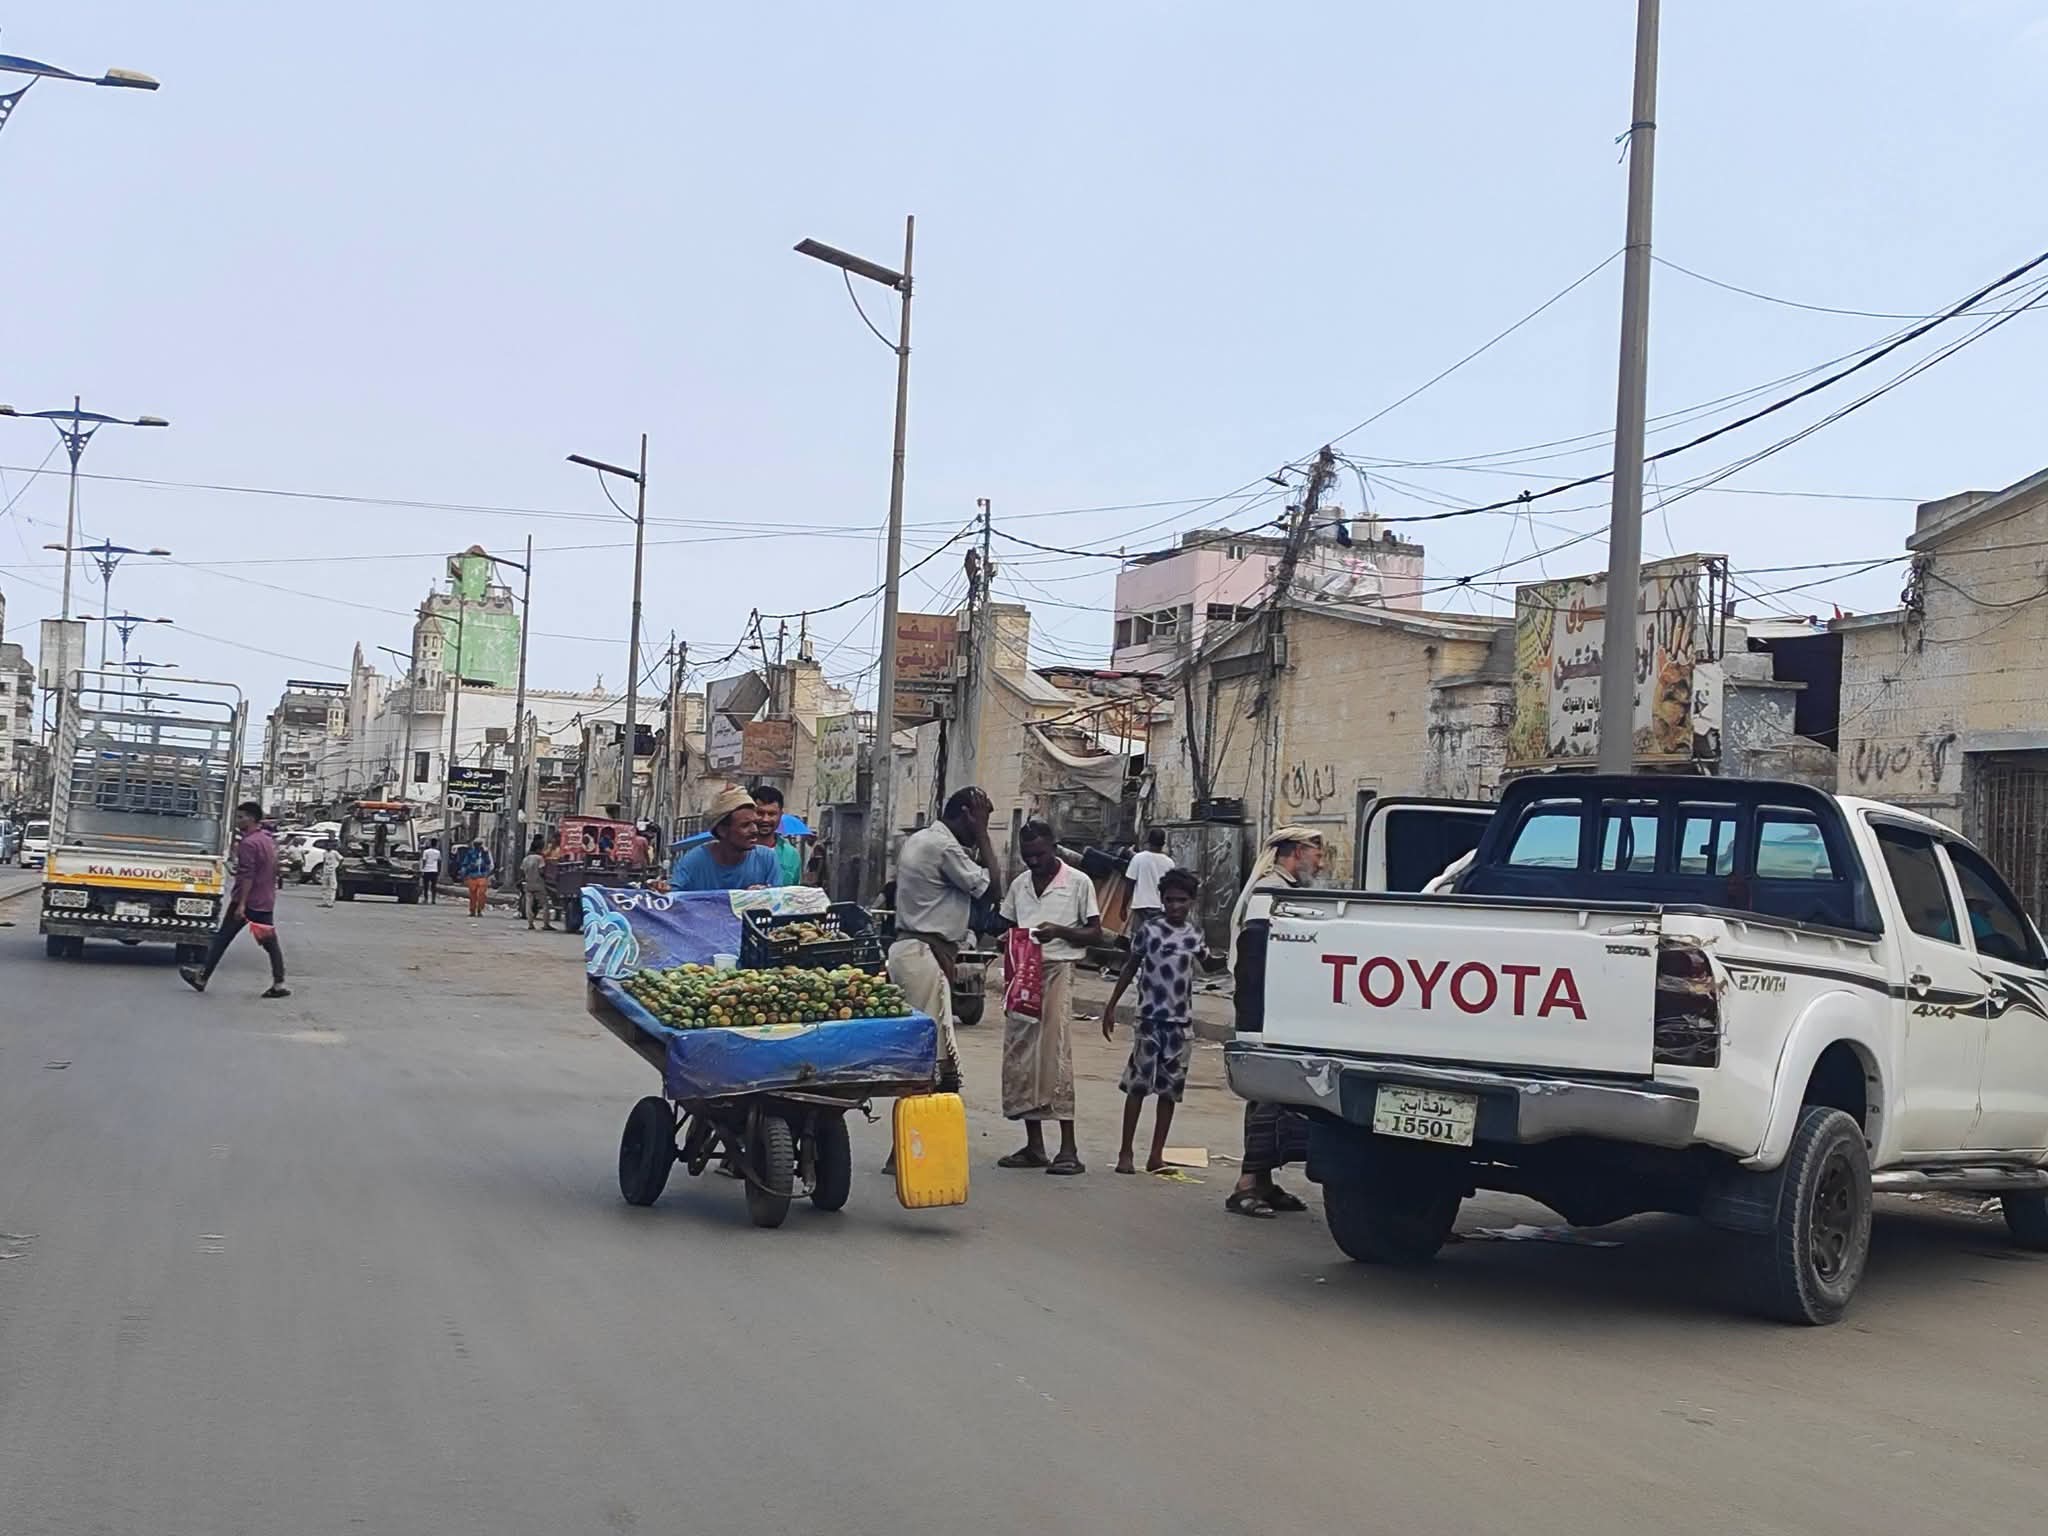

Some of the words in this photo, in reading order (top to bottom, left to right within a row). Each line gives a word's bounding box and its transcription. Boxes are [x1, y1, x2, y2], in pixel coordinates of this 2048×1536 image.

[89, 865, 115, 876] KIA
[119, 867, 170, 879] MOTO
[1321, 954, 1588, 1020] TOYOTA
[1391, 1115, 1454, 1140] 15501
